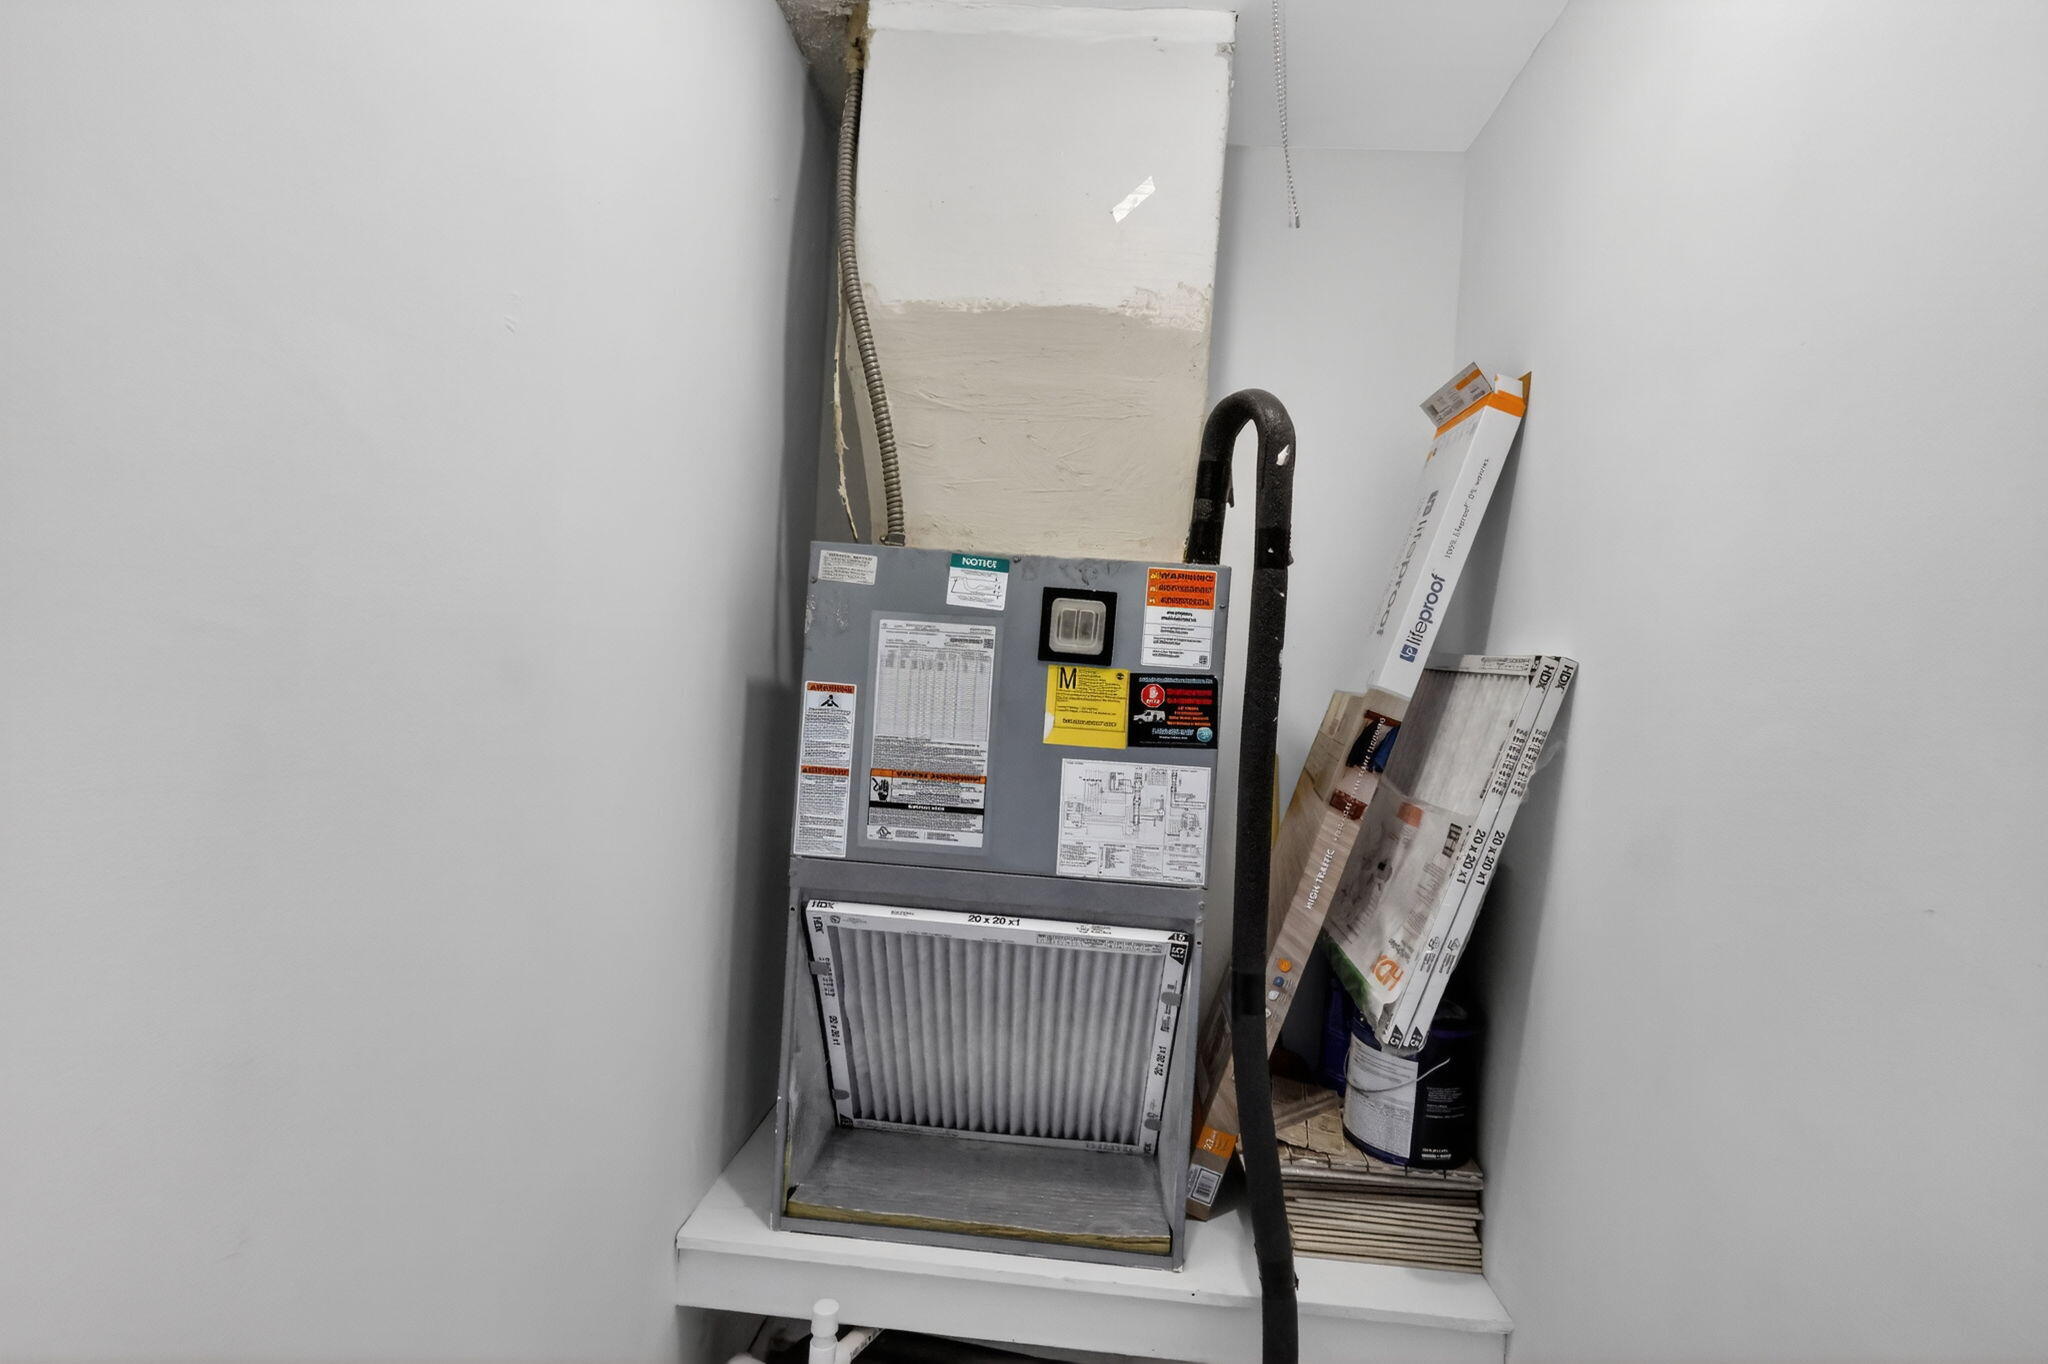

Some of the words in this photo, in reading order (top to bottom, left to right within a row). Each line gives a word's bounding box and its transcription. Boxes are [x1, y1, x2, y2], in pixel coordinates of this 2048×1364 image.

[962, 557, 997, 569] NOTICE
[1160, 572, 1213, 582] WARNING
[1406, 572, 1446, 647] lifeproof
[1059, 666, 1077, 689] M
[1535, 663, 1555, 690] HDX
[1555, 664, 1574, 690] HDX
[1473, 828, 1486, 844] 20
[1492, 830, 1505, 846] 20
[1468, 844, 1478, 853] x
[1487, 846, 1497, 855] x
[1462, 853, 1476, 869] 20
[1481, 855, 1495, 871] 20
[1306, 884, 1321, 910] HIGH
[1316, 848, 1335, 883] TRAFFIC
[811, 901, 836, 909] HDX
[812, 916, 825, 935] HDX
[968, 914, 981, 924] 20
[992, 915, 1006, 925] 20
